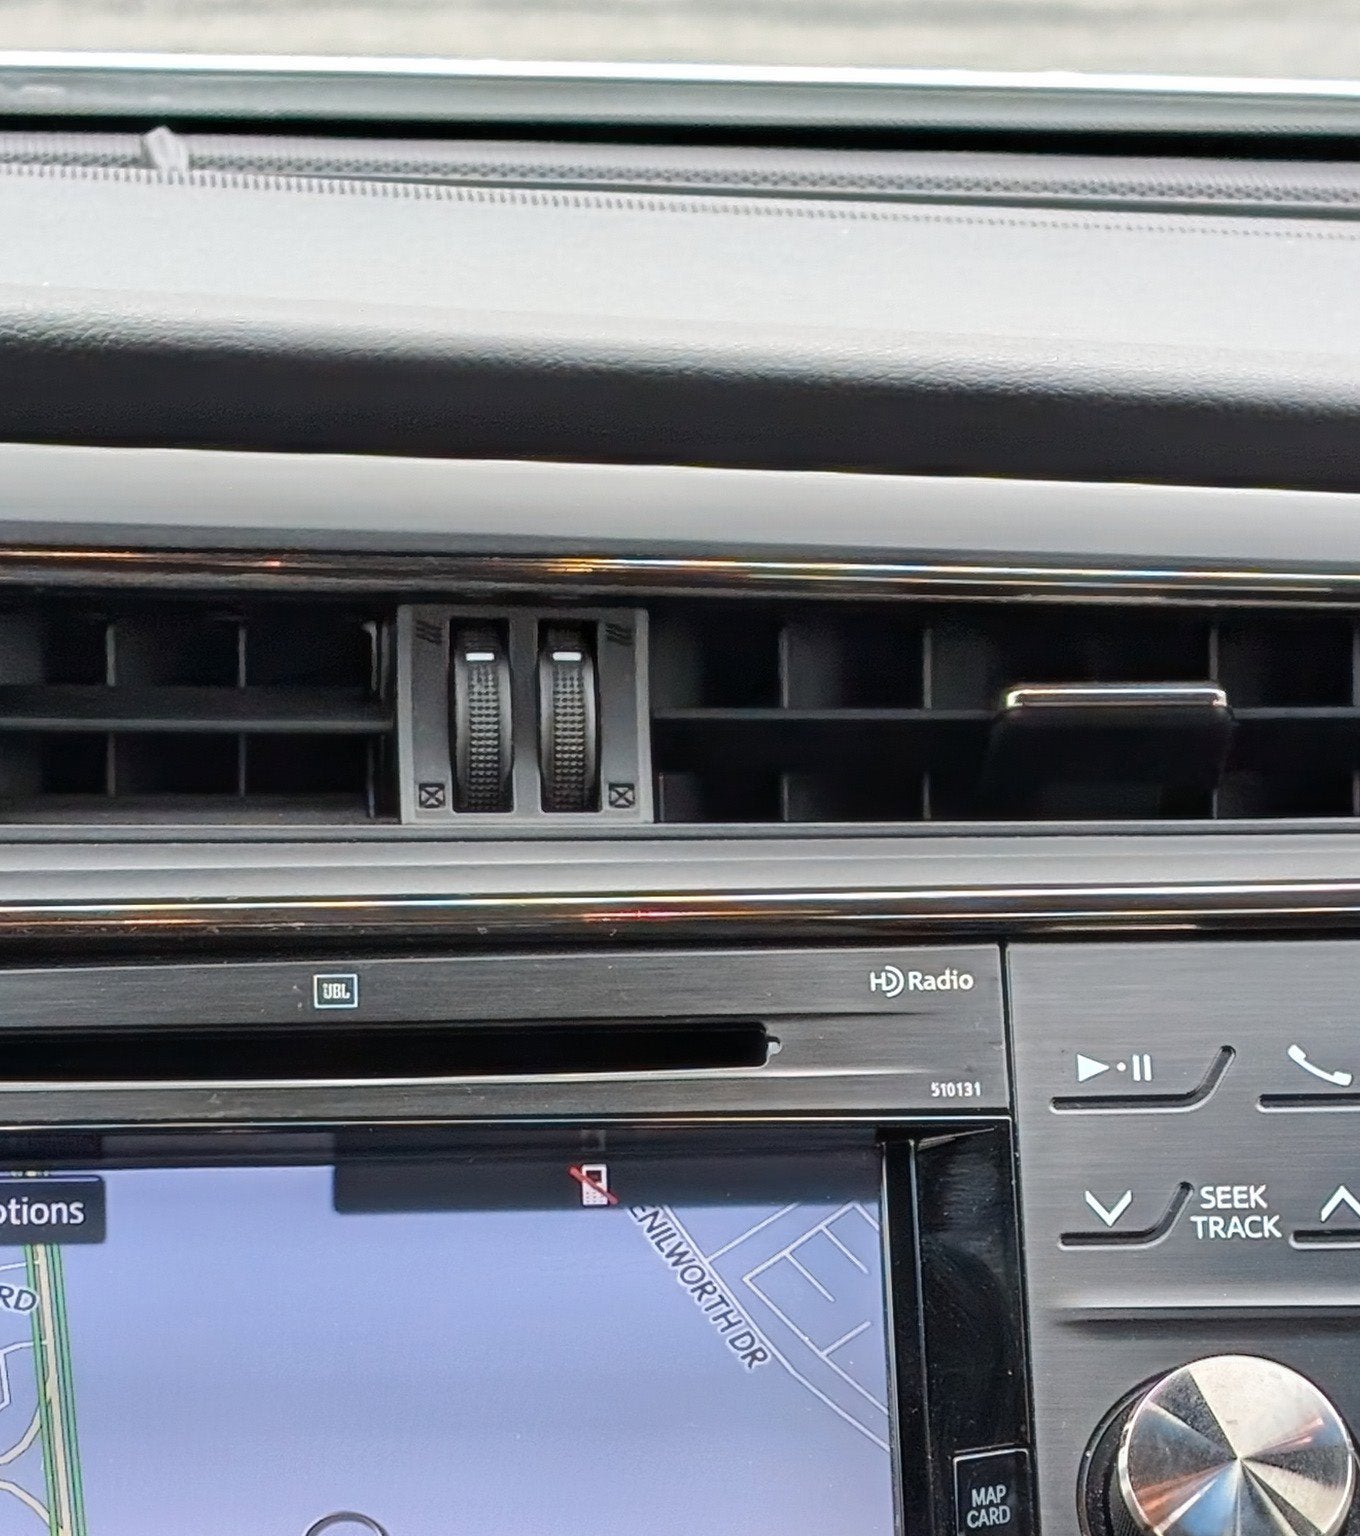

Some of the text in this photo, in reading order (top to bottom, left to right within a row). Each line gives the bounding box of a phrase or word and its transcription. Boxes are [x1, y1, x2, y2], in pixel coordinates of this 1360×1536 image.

[322, 983, 351, 999] JBL
[908, 967, 974, 991] Radio
[930, 1081, 981, 1097] 510131
[1199, 1185, 1269, 1209] SEEK
[1189, 1215, 1283, 1240] TRACK
[727, 1330, 769, 1370] DR
[971, 1484, 1007, 1508] MAP
[966, 1505, 1011, 1529] CARD
